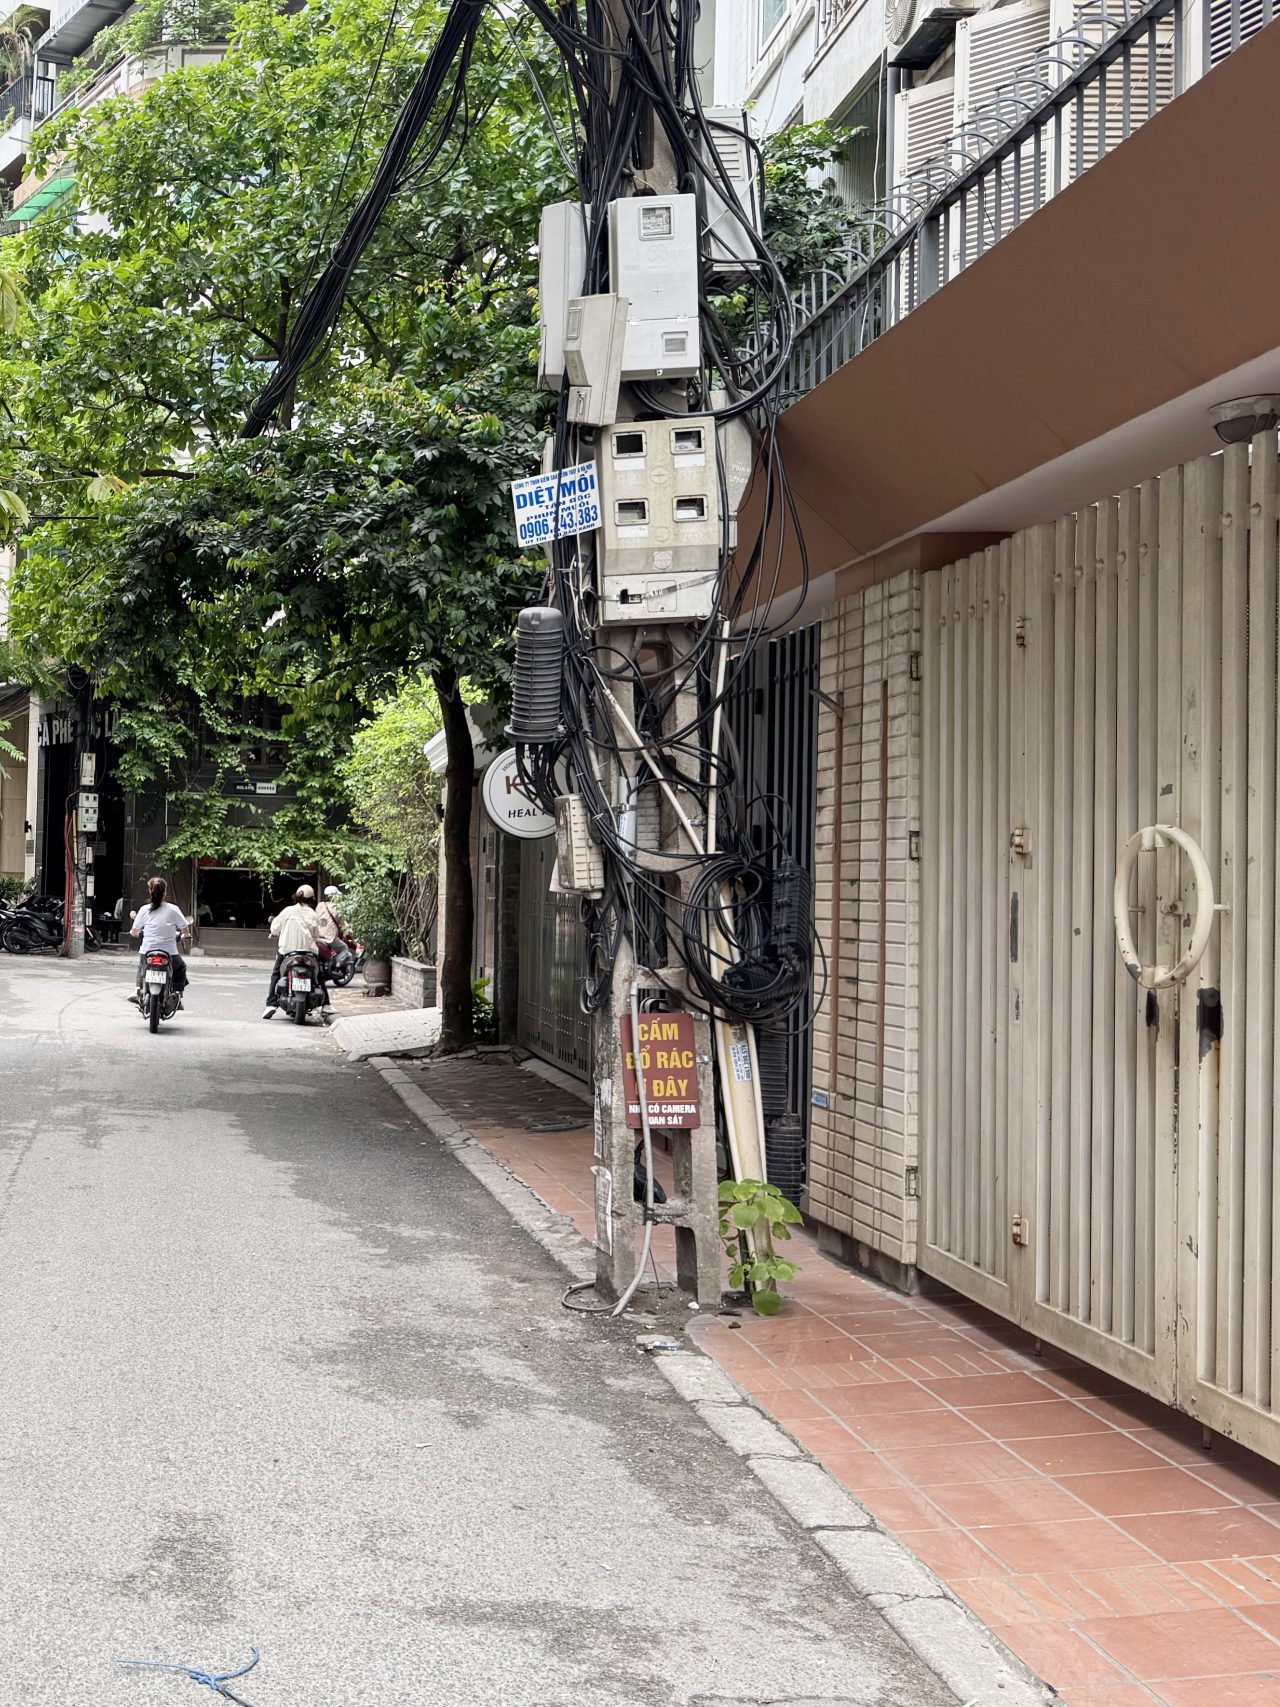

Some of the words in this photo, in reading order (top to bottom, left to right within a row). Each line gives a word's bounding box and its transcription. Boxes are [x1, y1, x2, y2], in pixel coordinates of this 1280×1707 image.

[516, 486, 554, 509] DIỆT
[560, 470, 595, 498] MỐI
[638, 1018, 679, 1041] CẤM
[656, 1047, 694, 1069] RÁC
[652, 1076, 688, 1096] ĐÂY
[648, 1102, 660, 1114] CÓ
[661, 1104, 697, 1114] CAMERA
[647, 1115, 666, 1125] UAN
[667, 1113, 684, 1125] SÁT
